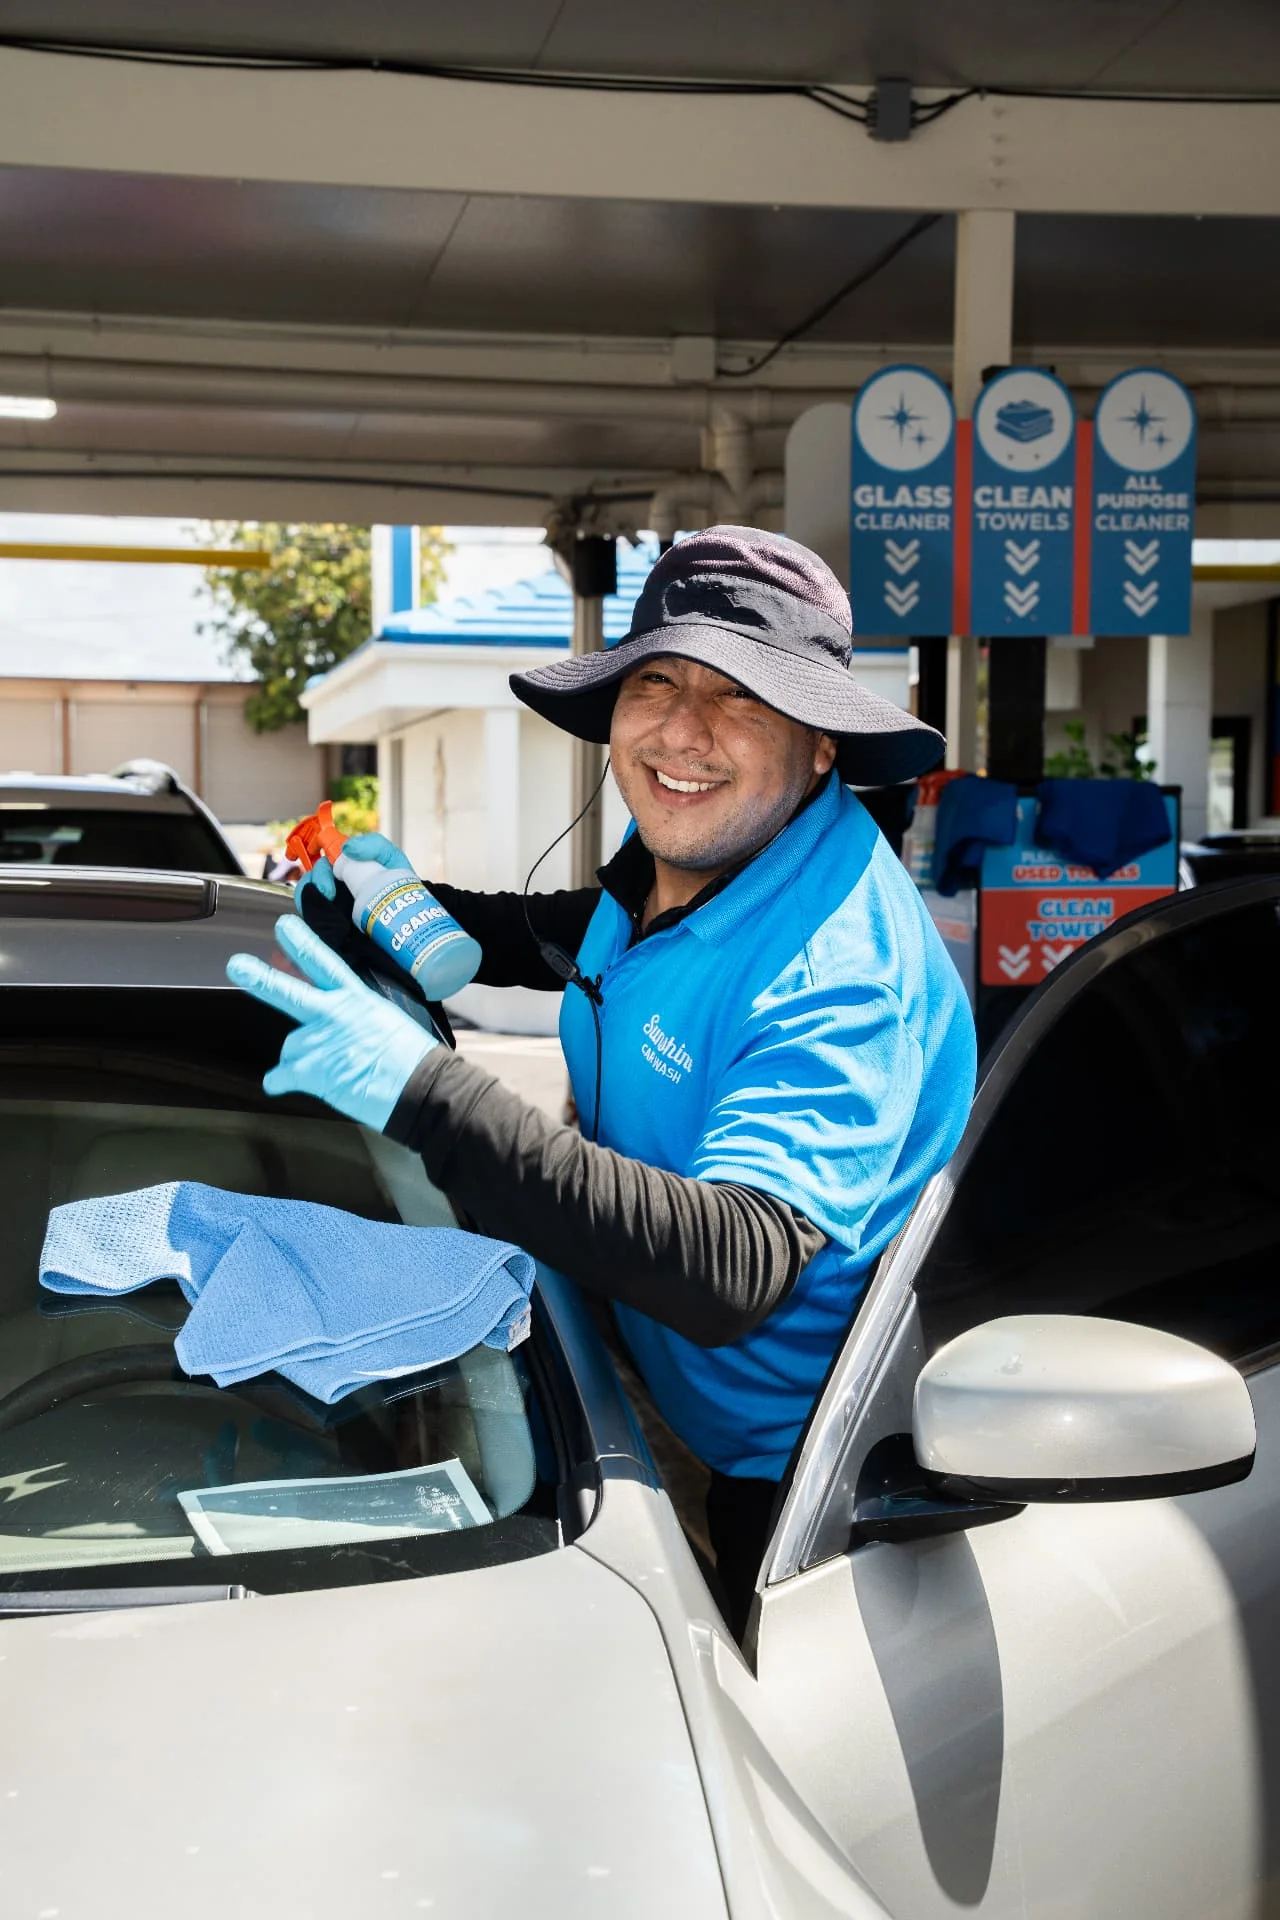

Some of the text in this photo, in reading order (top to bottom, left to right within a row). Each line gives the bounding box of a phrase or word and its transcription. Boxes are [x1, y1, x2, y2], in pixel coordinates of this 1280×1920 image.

[1124, 476, 1162, 491] ALL
[853, 485, 952, 509] GLASS
[974, 486, 1073, 509] CLEAN
[1097, 493, 1189, 509] PURPOSE
[854, 513, 951, 531] CLEANER
[976, 513, 1071, 531] TOWELS
[1095, 514, 1190, 531] CLEANER
[1013, 864, 1140, 881] USED TOLS
[380, 890, 425, 926] GLASS
[1037, 898, 1114, 919] CLEAN
[1027, 919, 1110, 941] TOWE
